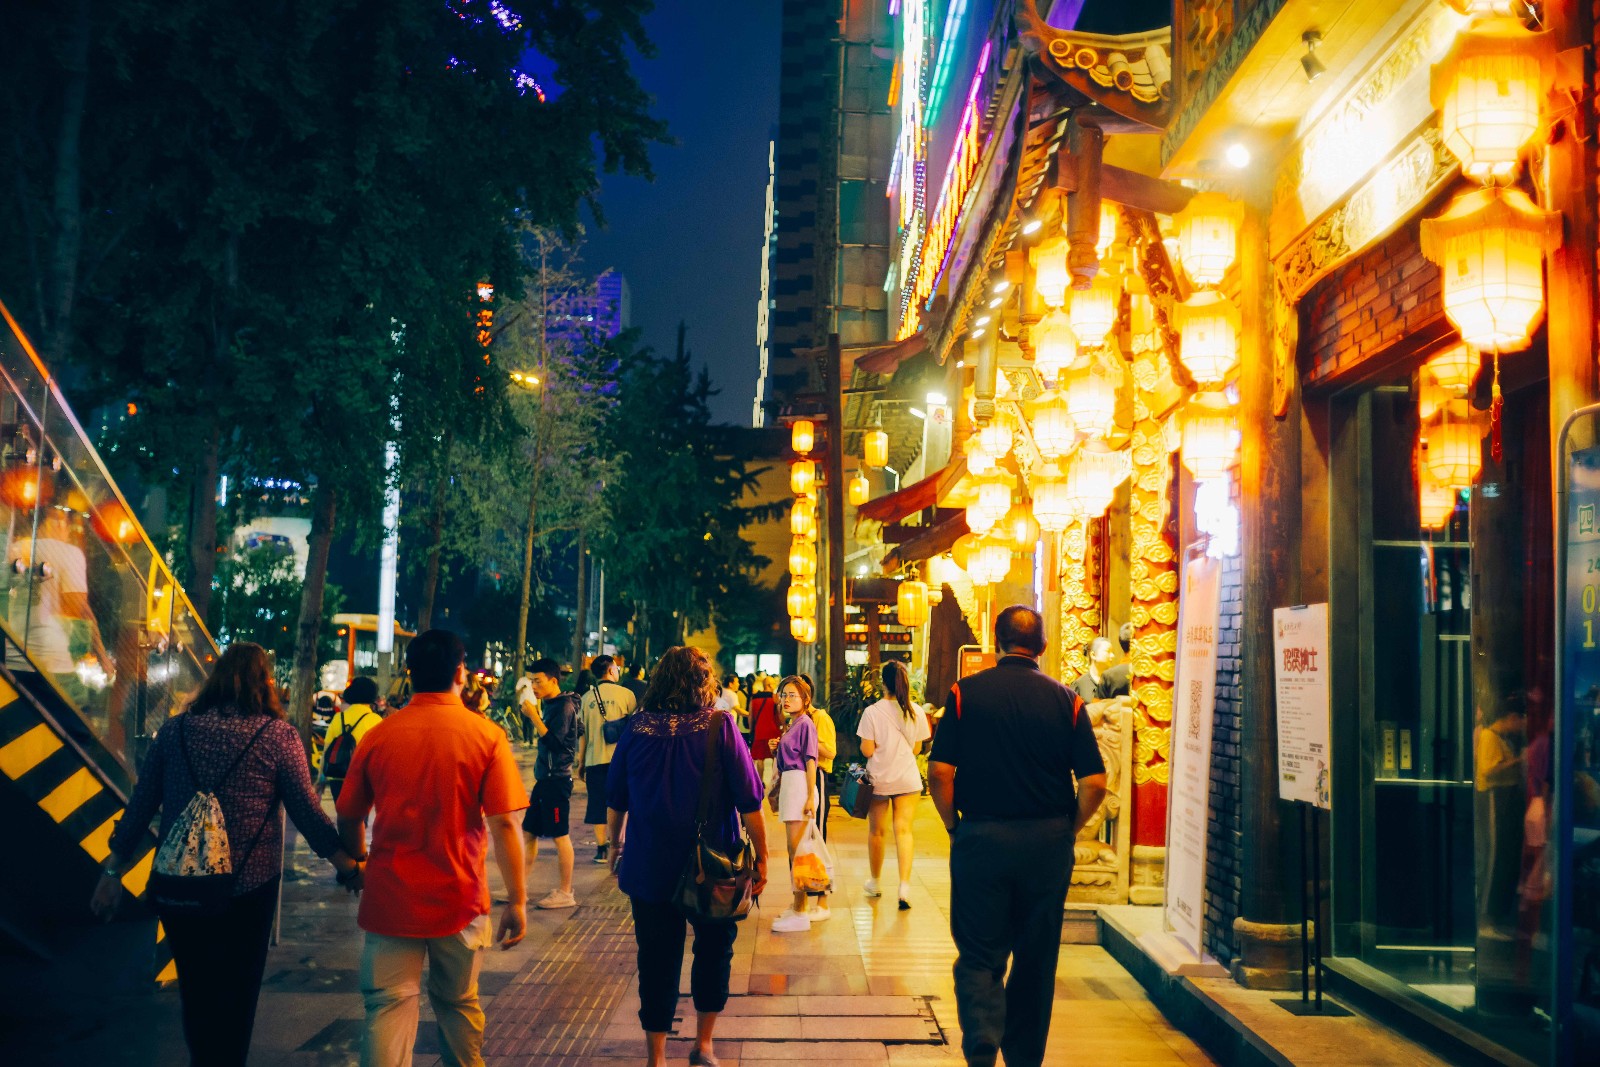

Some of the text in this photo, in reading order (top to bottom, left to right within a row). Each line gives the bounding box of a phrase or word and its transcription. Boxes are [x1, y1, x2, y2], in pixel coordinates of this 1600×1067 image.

[1578, 505, 1600, 534] 四
[1582, 583, 1600, 615] 0
[1283, 646, 1318, 673] 招贤纳士
